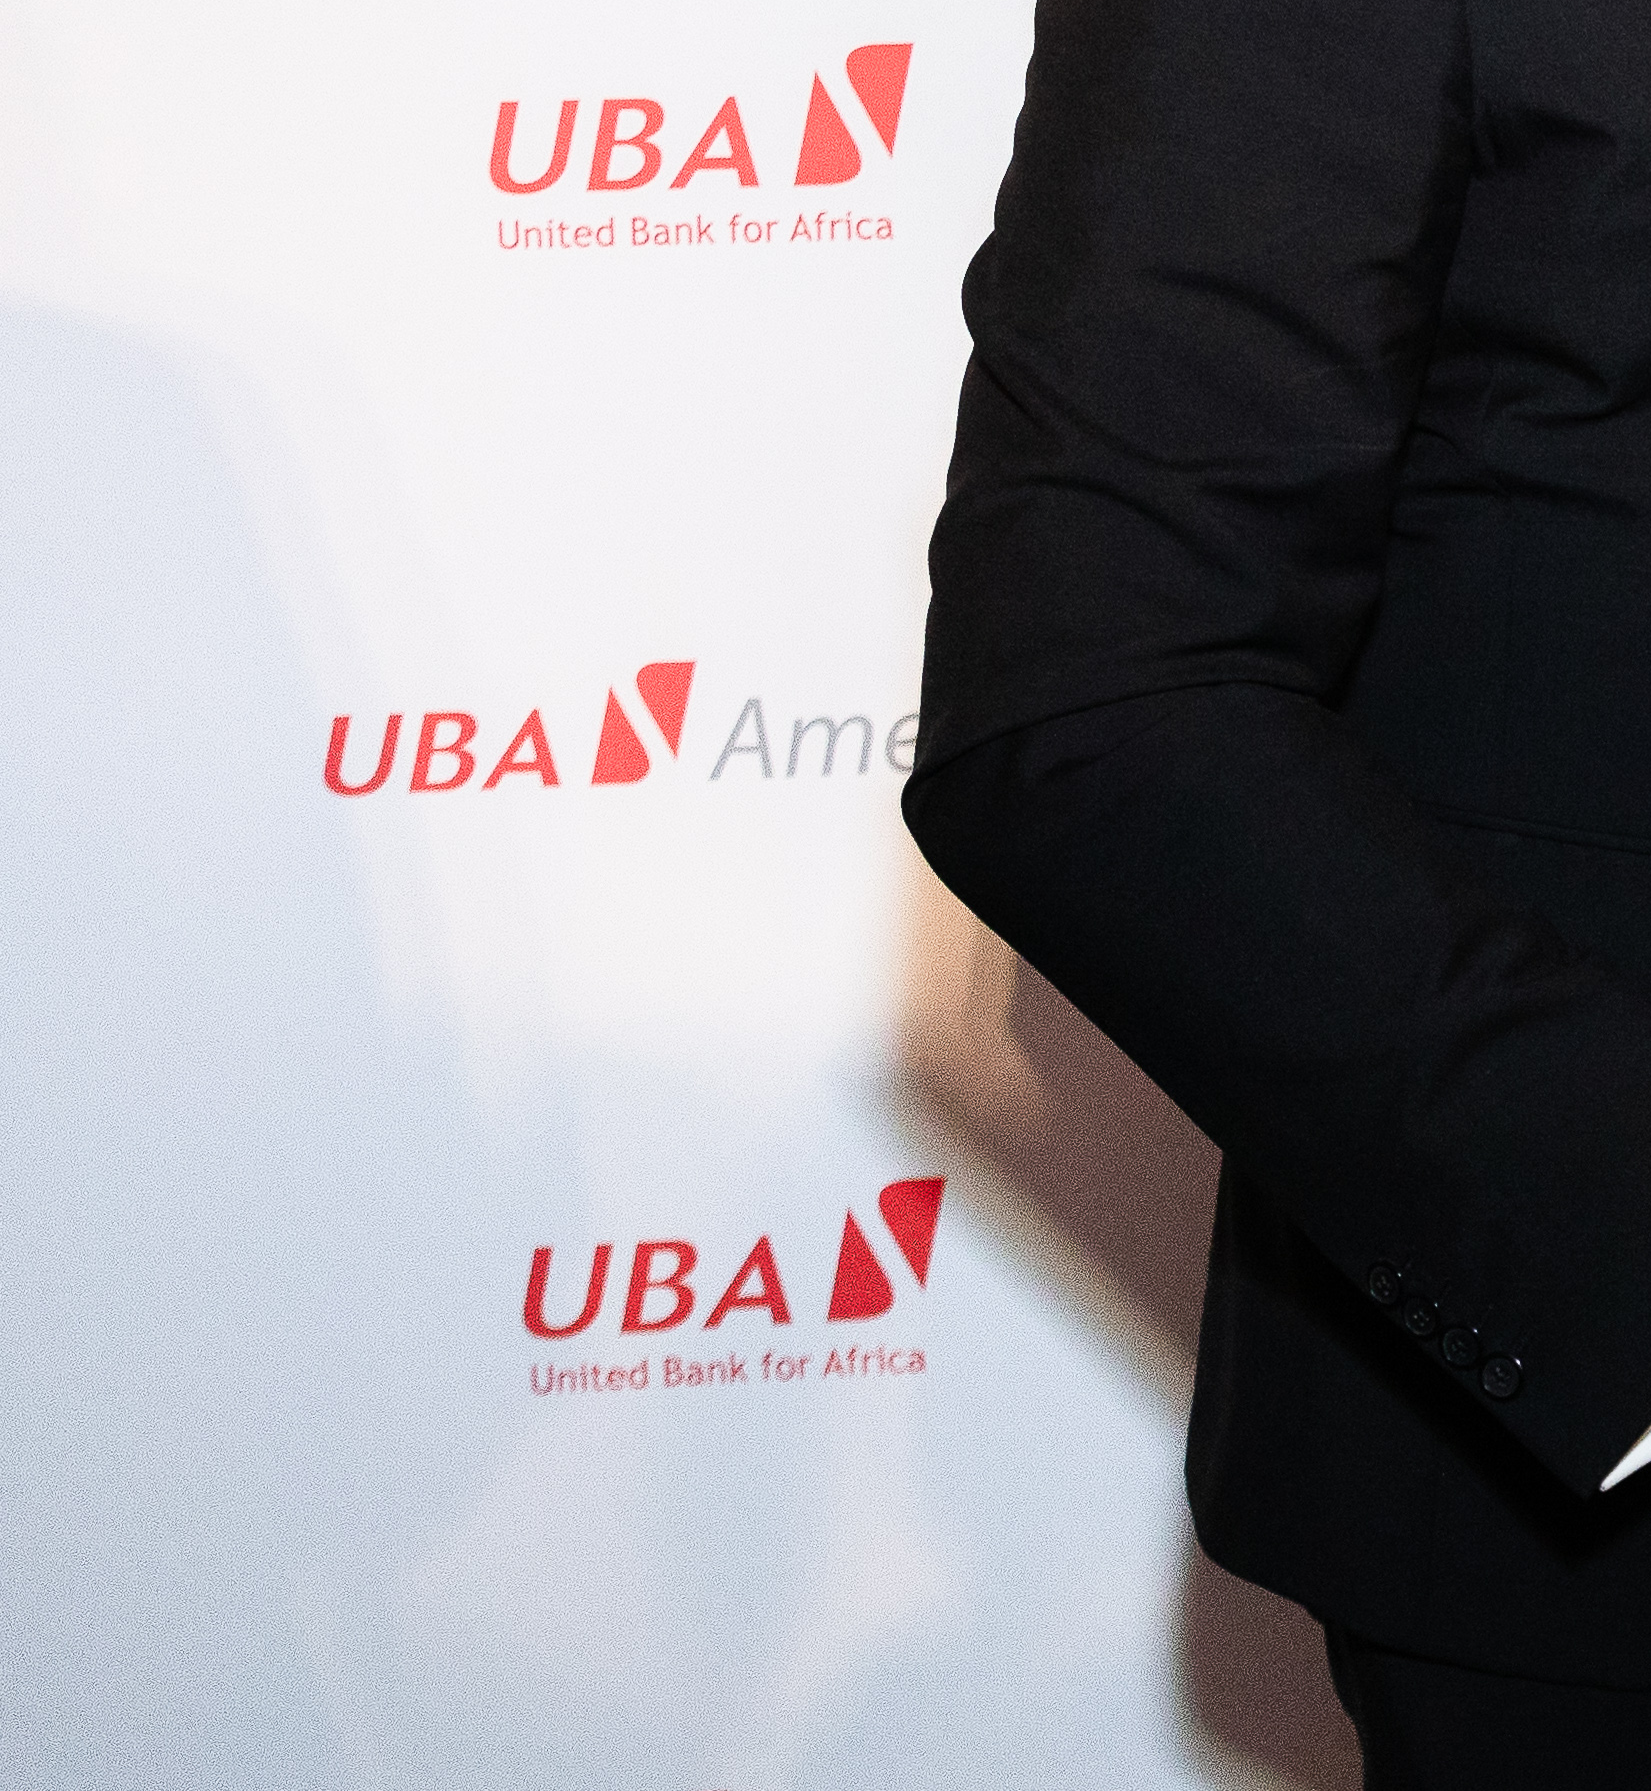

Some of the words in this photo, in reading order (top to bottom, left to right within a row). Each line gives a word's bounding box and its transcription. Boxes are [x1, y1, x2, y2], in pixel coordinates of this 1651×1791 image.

[487, 95, 761, 197] UBA
[497, 215, 616, 252] United
[629, 213, 715, 248] Bank
[728, 212, 778, 245] for
[789, 210, 895, 243] Africa
[322, 707, 561, 798] UBA
[522, 1234, 792, 1340] UBA
[529, 1357, 650, 1396] United
[662, 1352, 747, 1389] Bank
[761, 1349, 810, 1382] for
[822, 1345, 928, 1379] Africa
